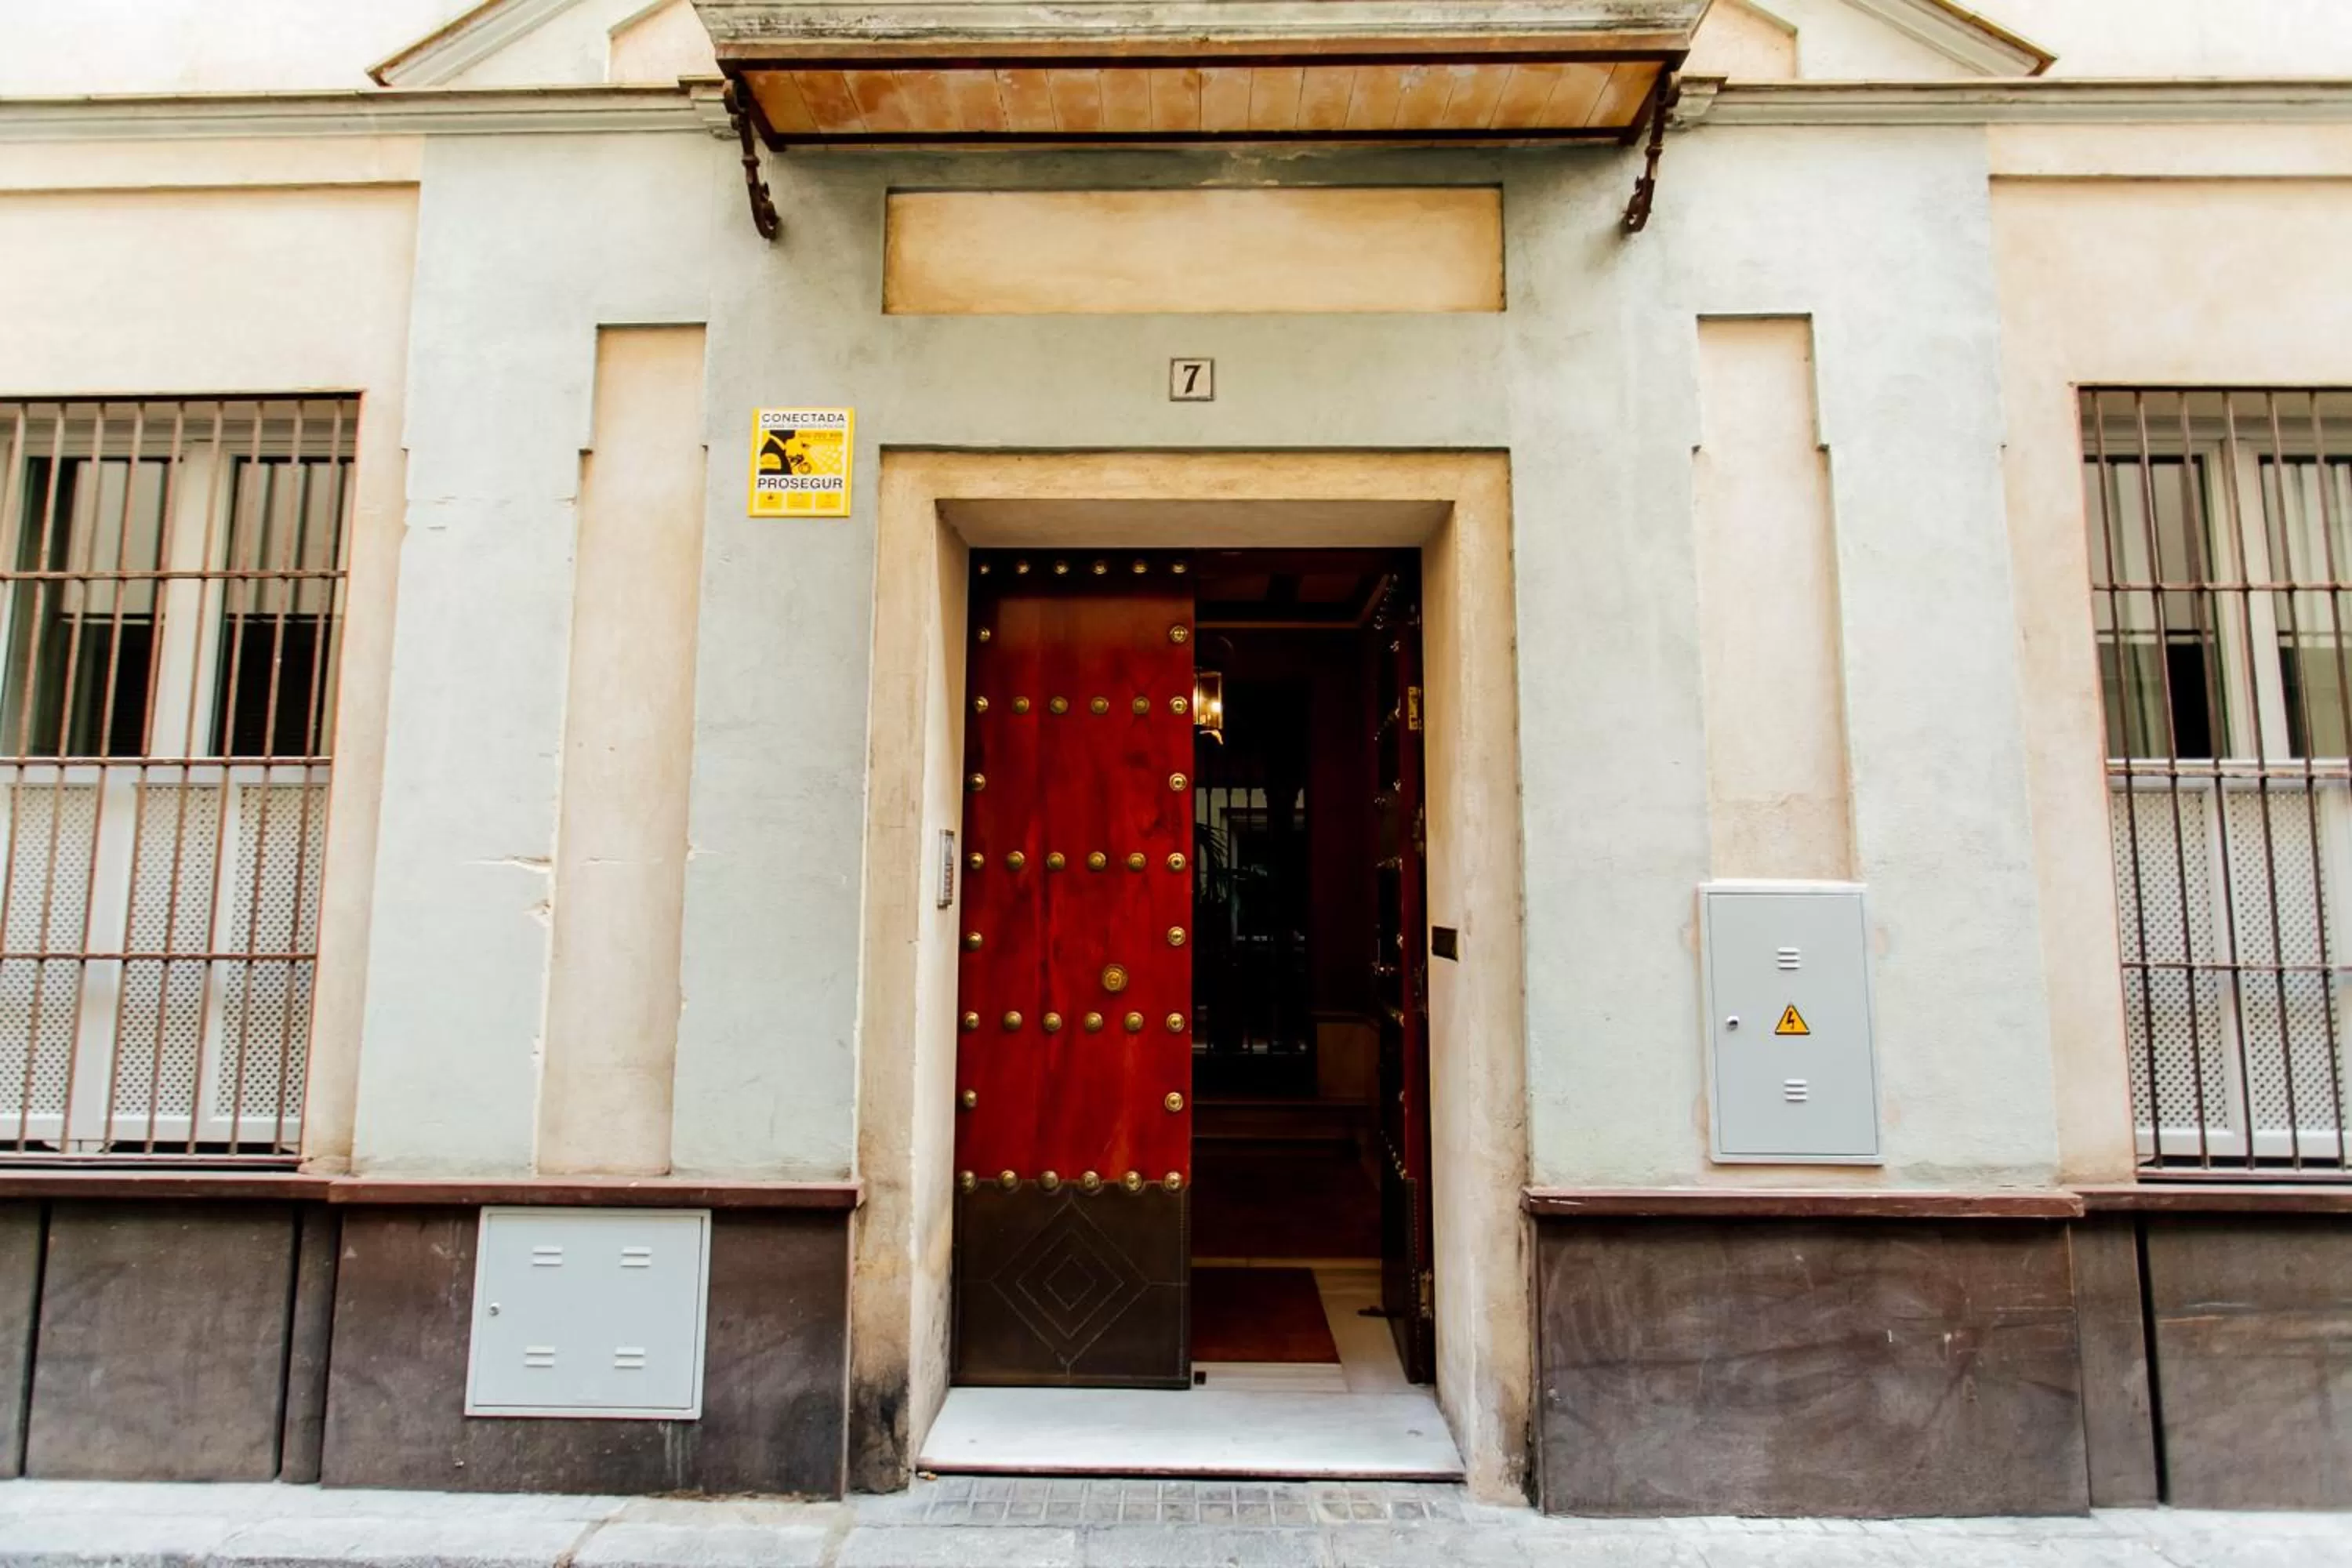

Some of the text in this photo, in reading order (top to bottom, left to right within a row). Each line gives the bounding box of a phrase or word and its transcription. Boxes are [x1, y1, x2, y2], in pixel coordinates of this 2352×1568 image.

[1183, 365, 1202, 394] 7
[761, 413, 845, 423] CONECTADA
[757, 477, 843, 489] PROSEGUR
